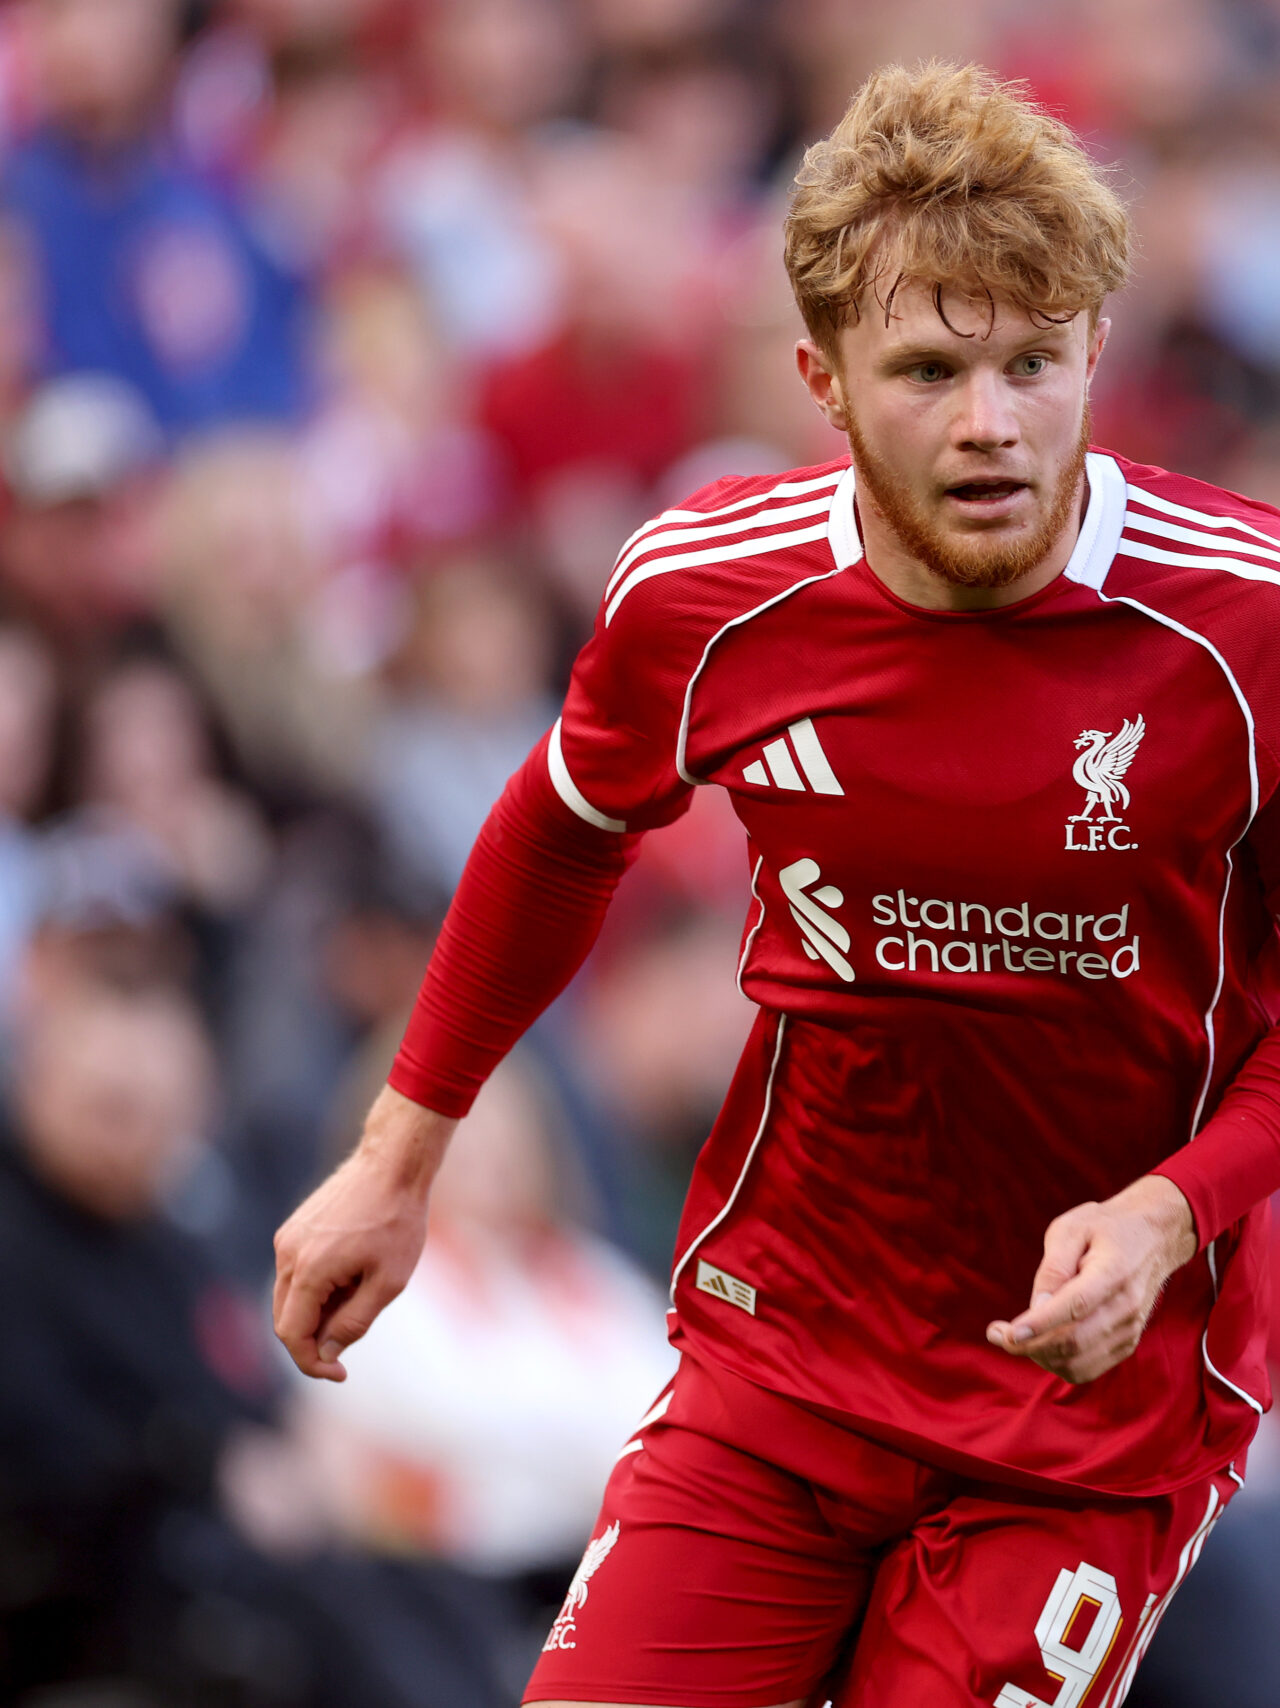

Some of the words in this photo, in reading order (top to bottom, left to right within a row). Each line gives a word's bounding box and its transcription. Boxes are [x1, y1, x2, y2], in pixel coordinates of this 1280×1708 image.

[1064, 824, 1139, 852] L.F.C.
[871, 888, 1129, 942] standard
[875, 930, 1140, 980] chartered
